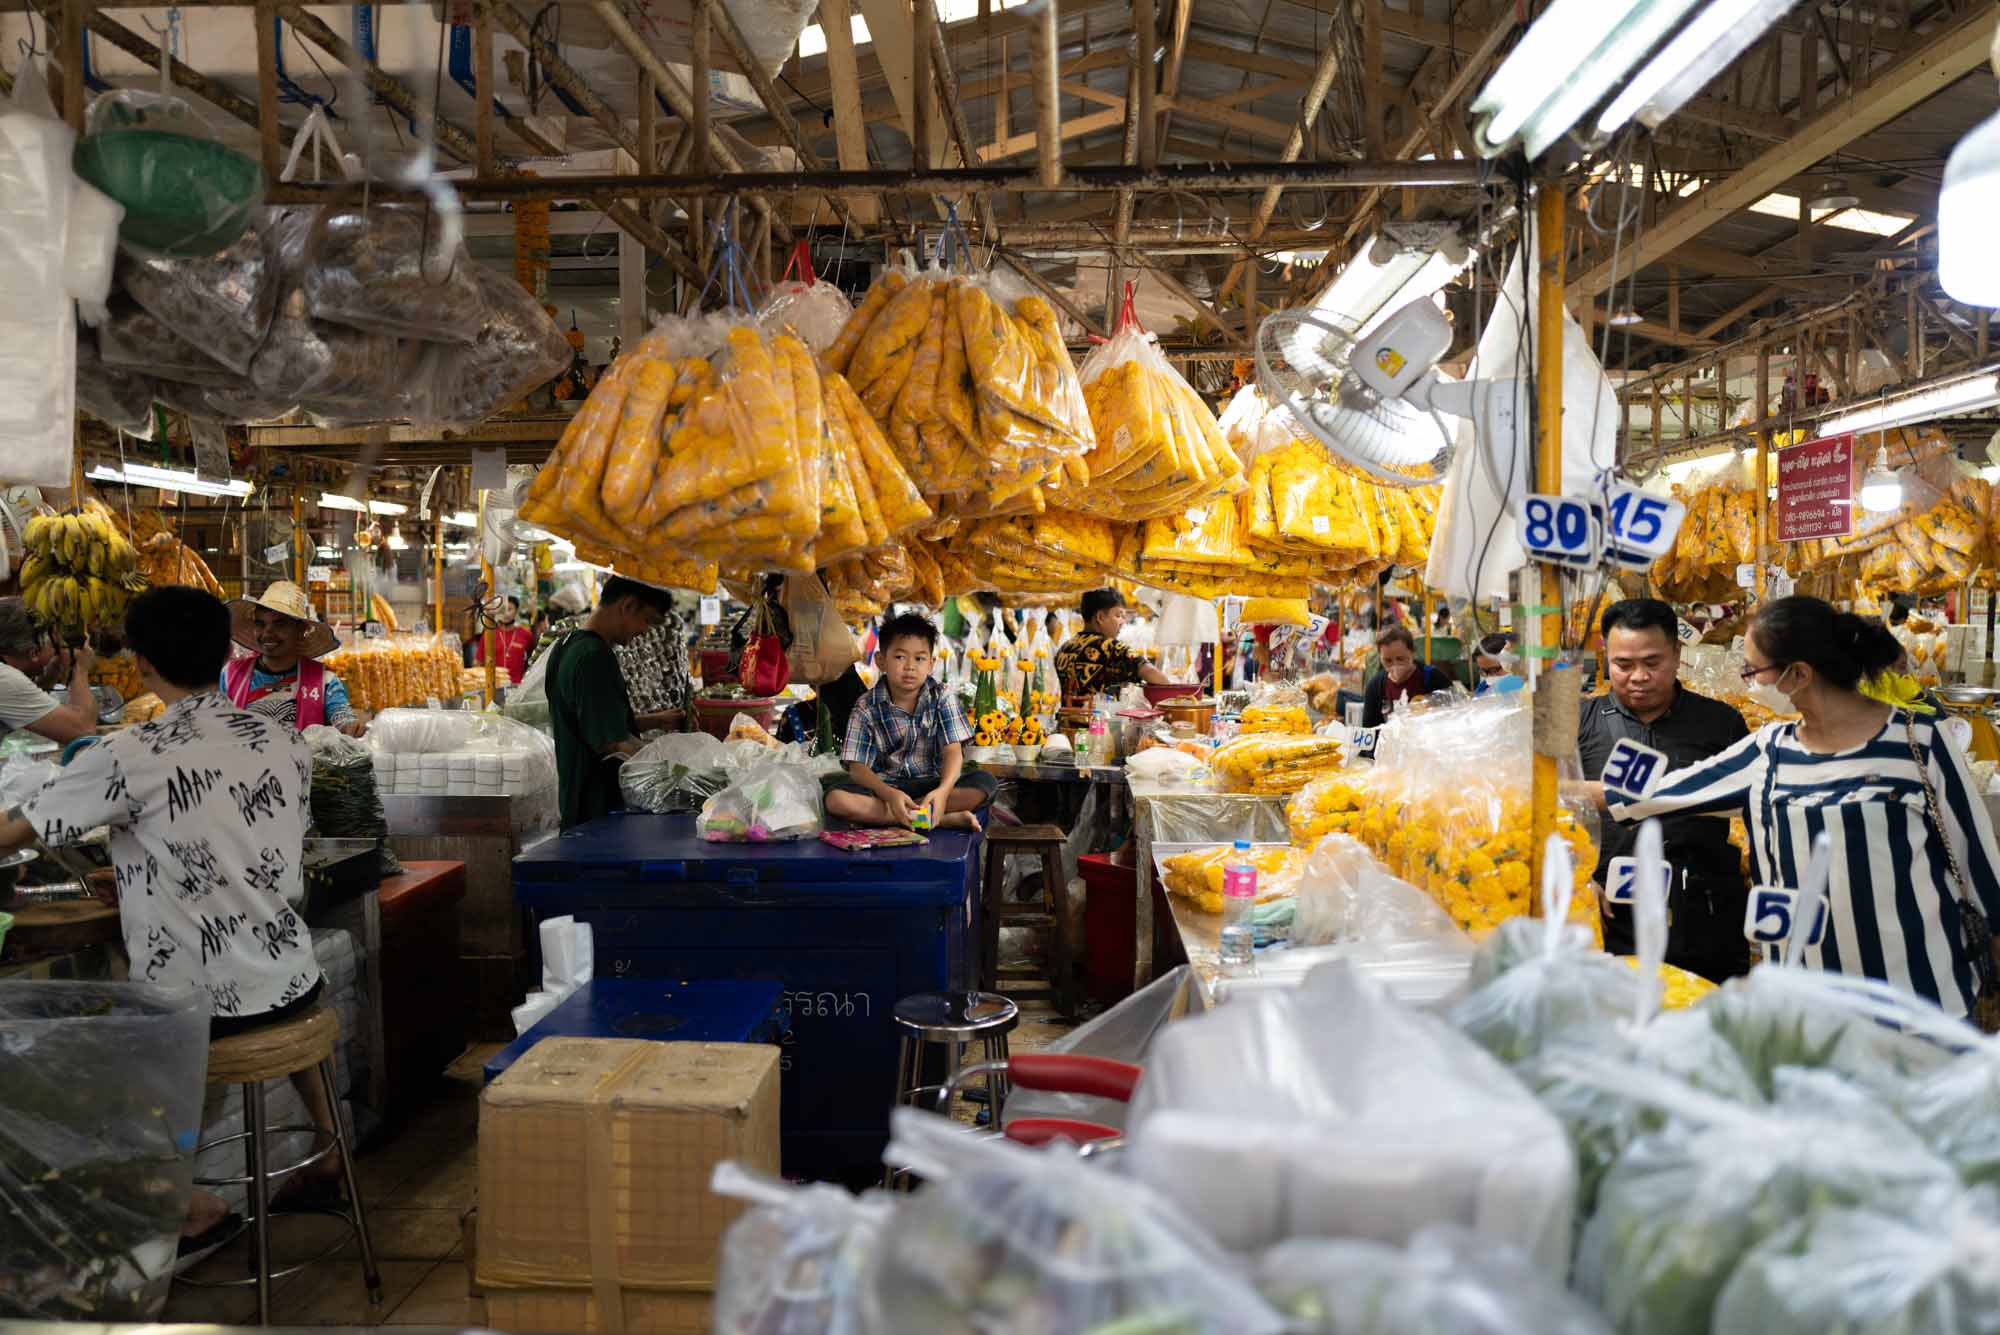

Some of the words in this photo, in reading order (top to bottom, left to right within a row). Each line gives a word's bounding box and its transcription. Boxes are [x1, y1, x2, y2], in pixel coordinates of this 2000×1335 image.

[1525, 498, 1587, 550] 80
[1608, 491, 1669, 545] 15
[1353, 731, 1374, 747] 40
[1603, 743, 1659, 795] 30
[1614, 864, 1671, 900] 2
[1753, 890, 1826, 946] 5
